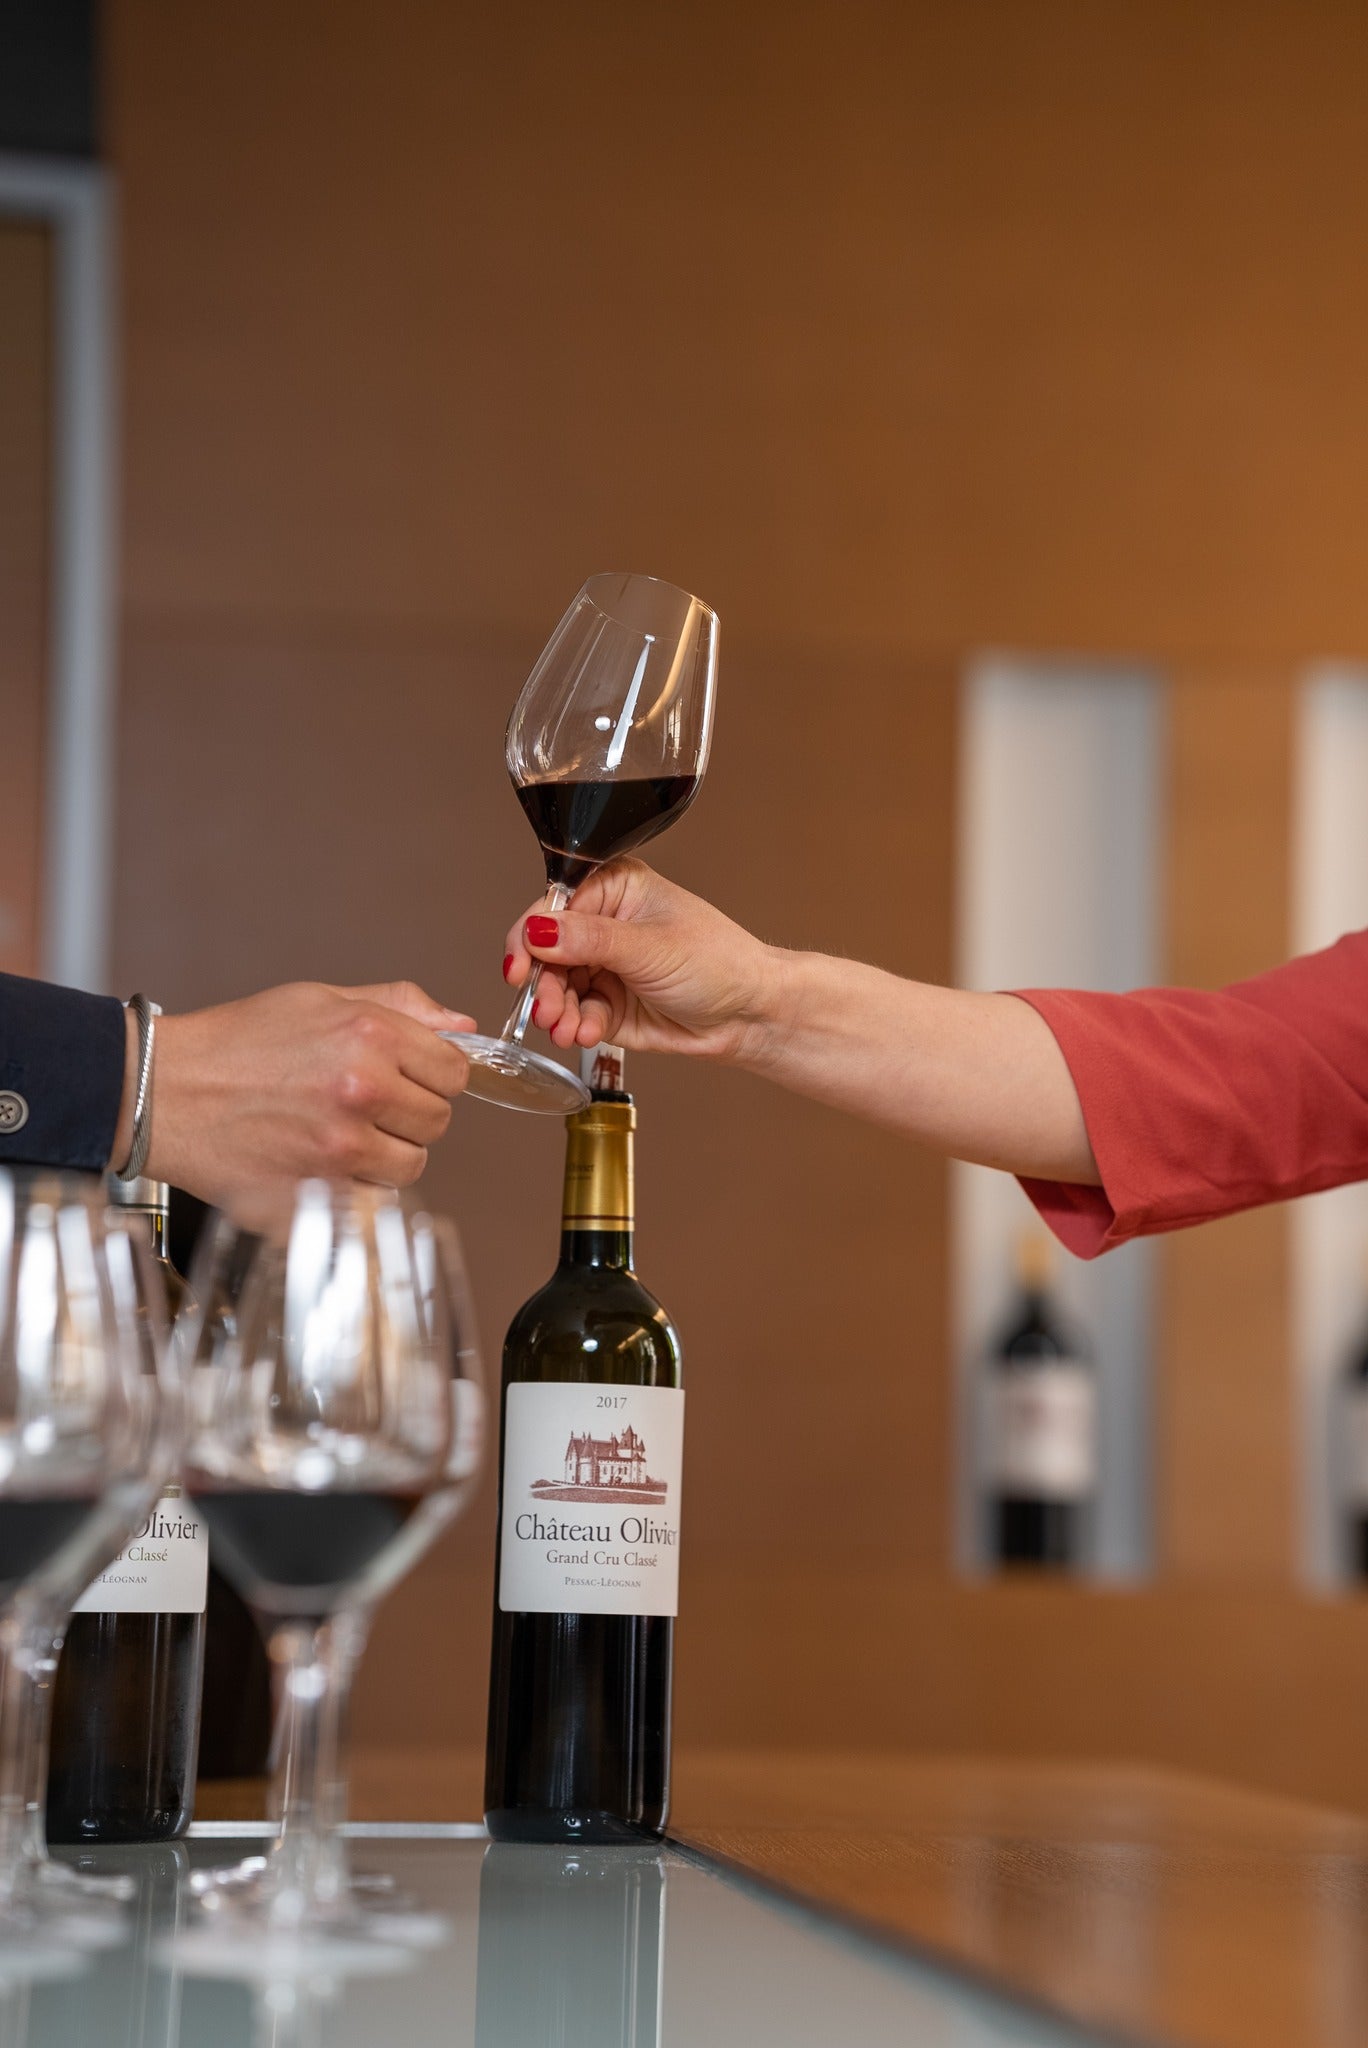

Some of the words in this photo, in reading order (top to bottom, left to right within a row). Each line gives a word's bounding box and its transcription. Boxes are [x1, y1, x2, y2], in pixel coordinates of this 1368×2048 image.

[596, 1395, 627, 1409] 2017
[515, 1513, 611, 1542] Château
[128, 1547, 168, 1562] Classé
[546, 1549, 589, 1565] Grand
[593, 1550, 619, 1566] Cru
[624, 1551, 657, 1567] Classé
